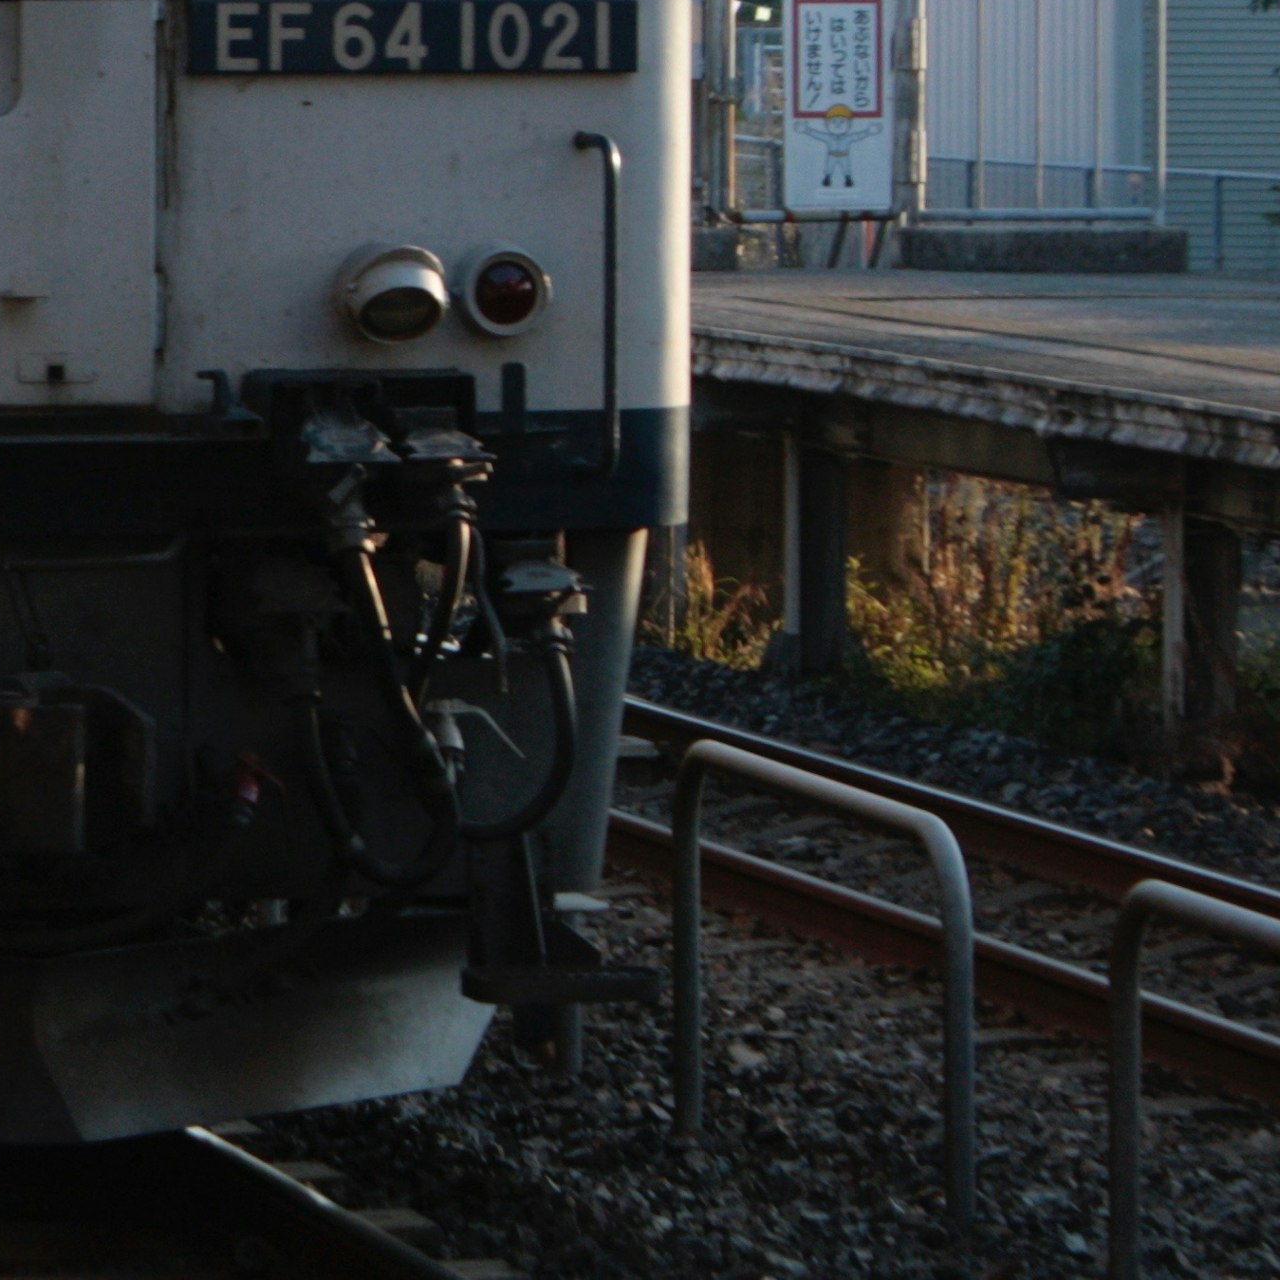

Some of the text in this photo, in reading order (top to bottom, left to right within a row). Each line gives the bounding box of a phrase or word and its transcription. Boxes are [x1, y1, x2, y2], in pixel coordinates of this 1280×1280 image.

[460, 1, 610, 71] 1021
[830, 17, 848, 96] はいっては
[852, 9, 872, 108] あぶないから
